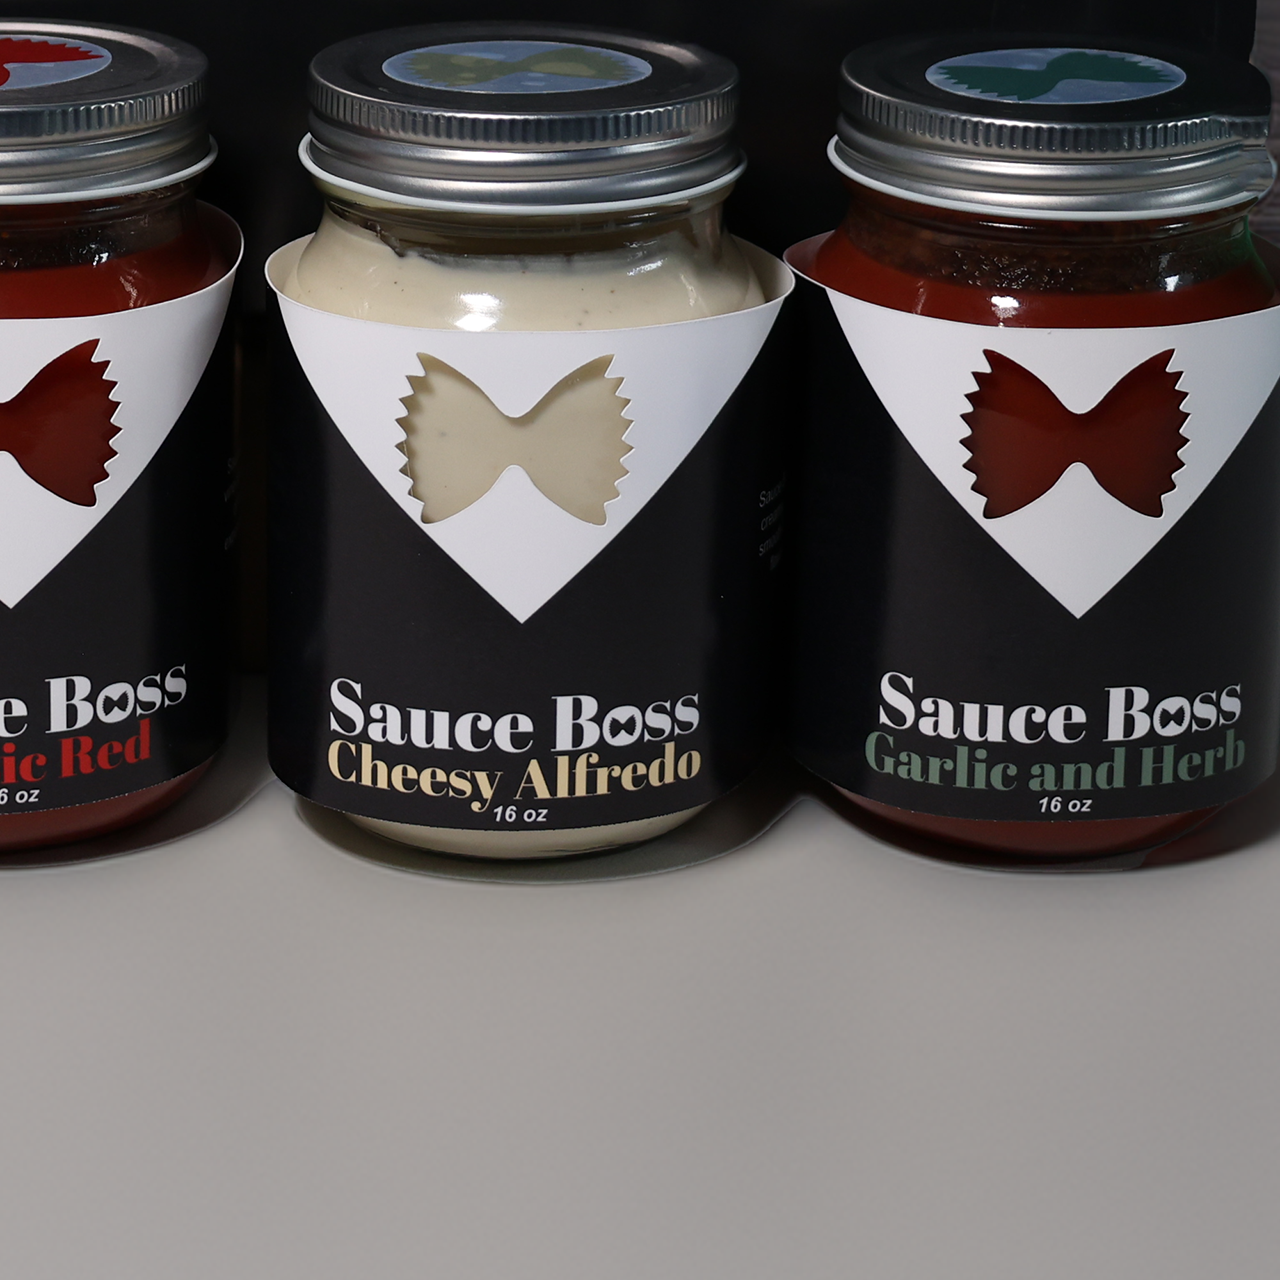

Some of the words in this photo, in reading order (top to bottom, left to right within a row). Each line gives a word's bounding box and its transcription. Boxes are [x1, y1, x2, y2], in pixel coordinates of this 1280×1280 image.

[44, 664, 188, 734] Boss
[328, 677, 535, 754] Sauce
[550, 692, 701, 752] Boss
[878, 671, 1087, 745] Sauce
[1102, 683, 1243, 742] Boss
[59, 717, 153, 779] Red
[327, 739, 504, 813] Cheesy
[512, 740, 703, 800] Alfredo
[864, 730, 1019, 791] Garlic
[1027, 746, 1127, 791] and
[1138, 728, 1246, 788] Herb
[14, 788, 41, 805] oz
[493, 805, 518, 823] 16
[522, 807, 549, 823] oz
[1037, 795, 1063, 813] 16
[1067, 799, 1093, 813] oz
